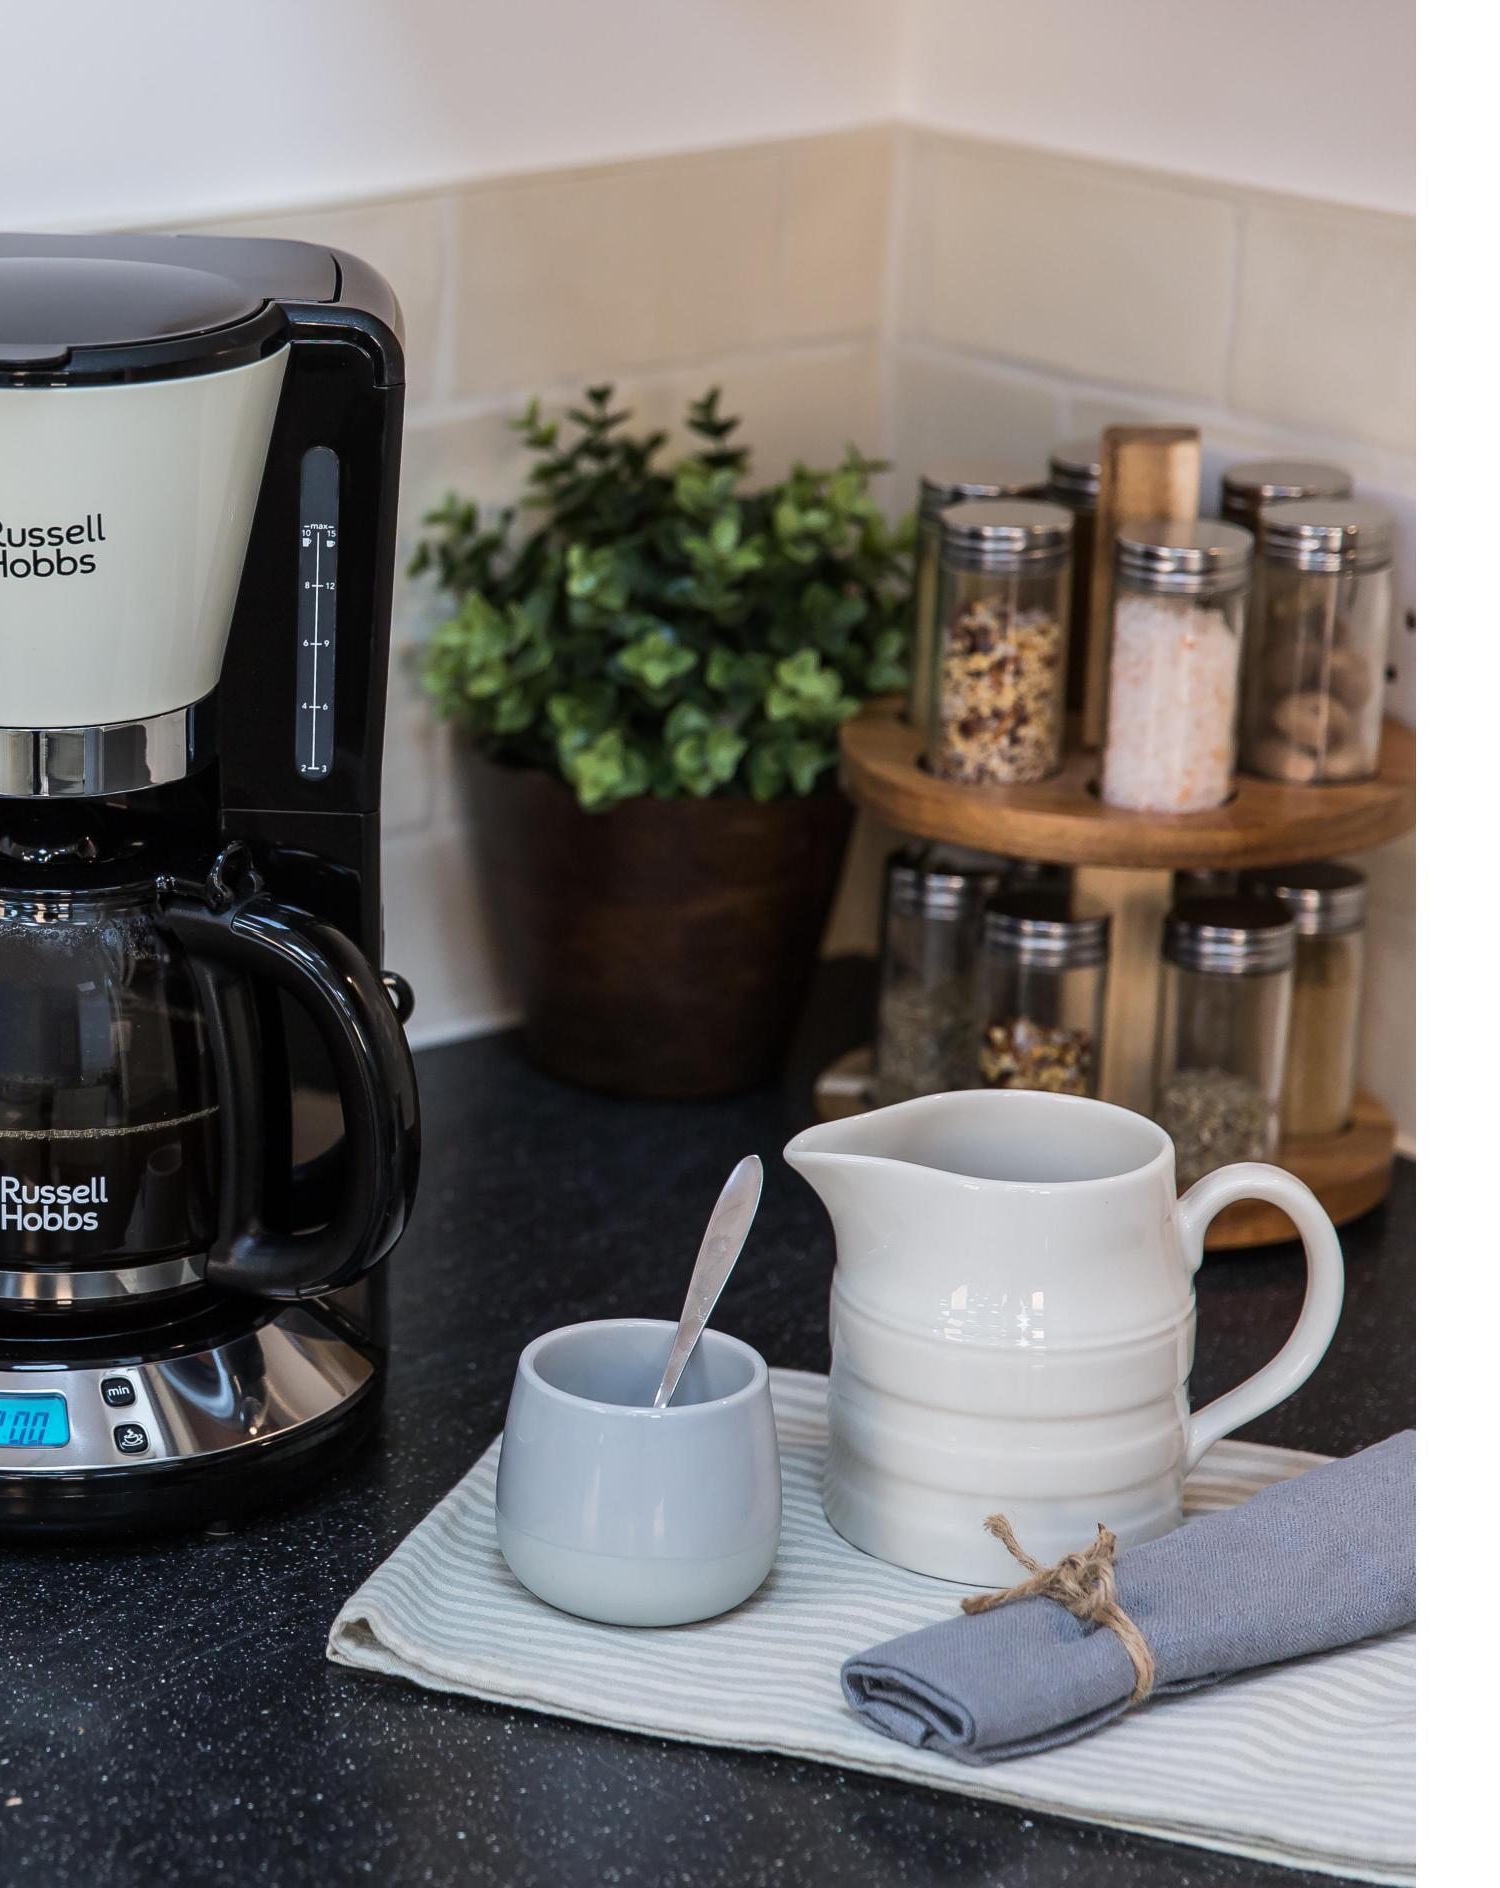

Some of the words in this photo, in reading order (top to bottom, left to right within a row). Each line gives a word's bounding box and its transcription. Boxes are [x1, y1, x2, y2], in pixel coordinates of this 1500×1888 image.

[302, 529, 311, 537] 10
[304, 581, 310, 589] 8
[326, 582, 335, 590] 12
[323, 703, 328, 711] 6
[1, 1176, 108, 1204] Russell
[1, 1204, 99, 1231] Hobbs
[108, 1385, 130, 1395] min
